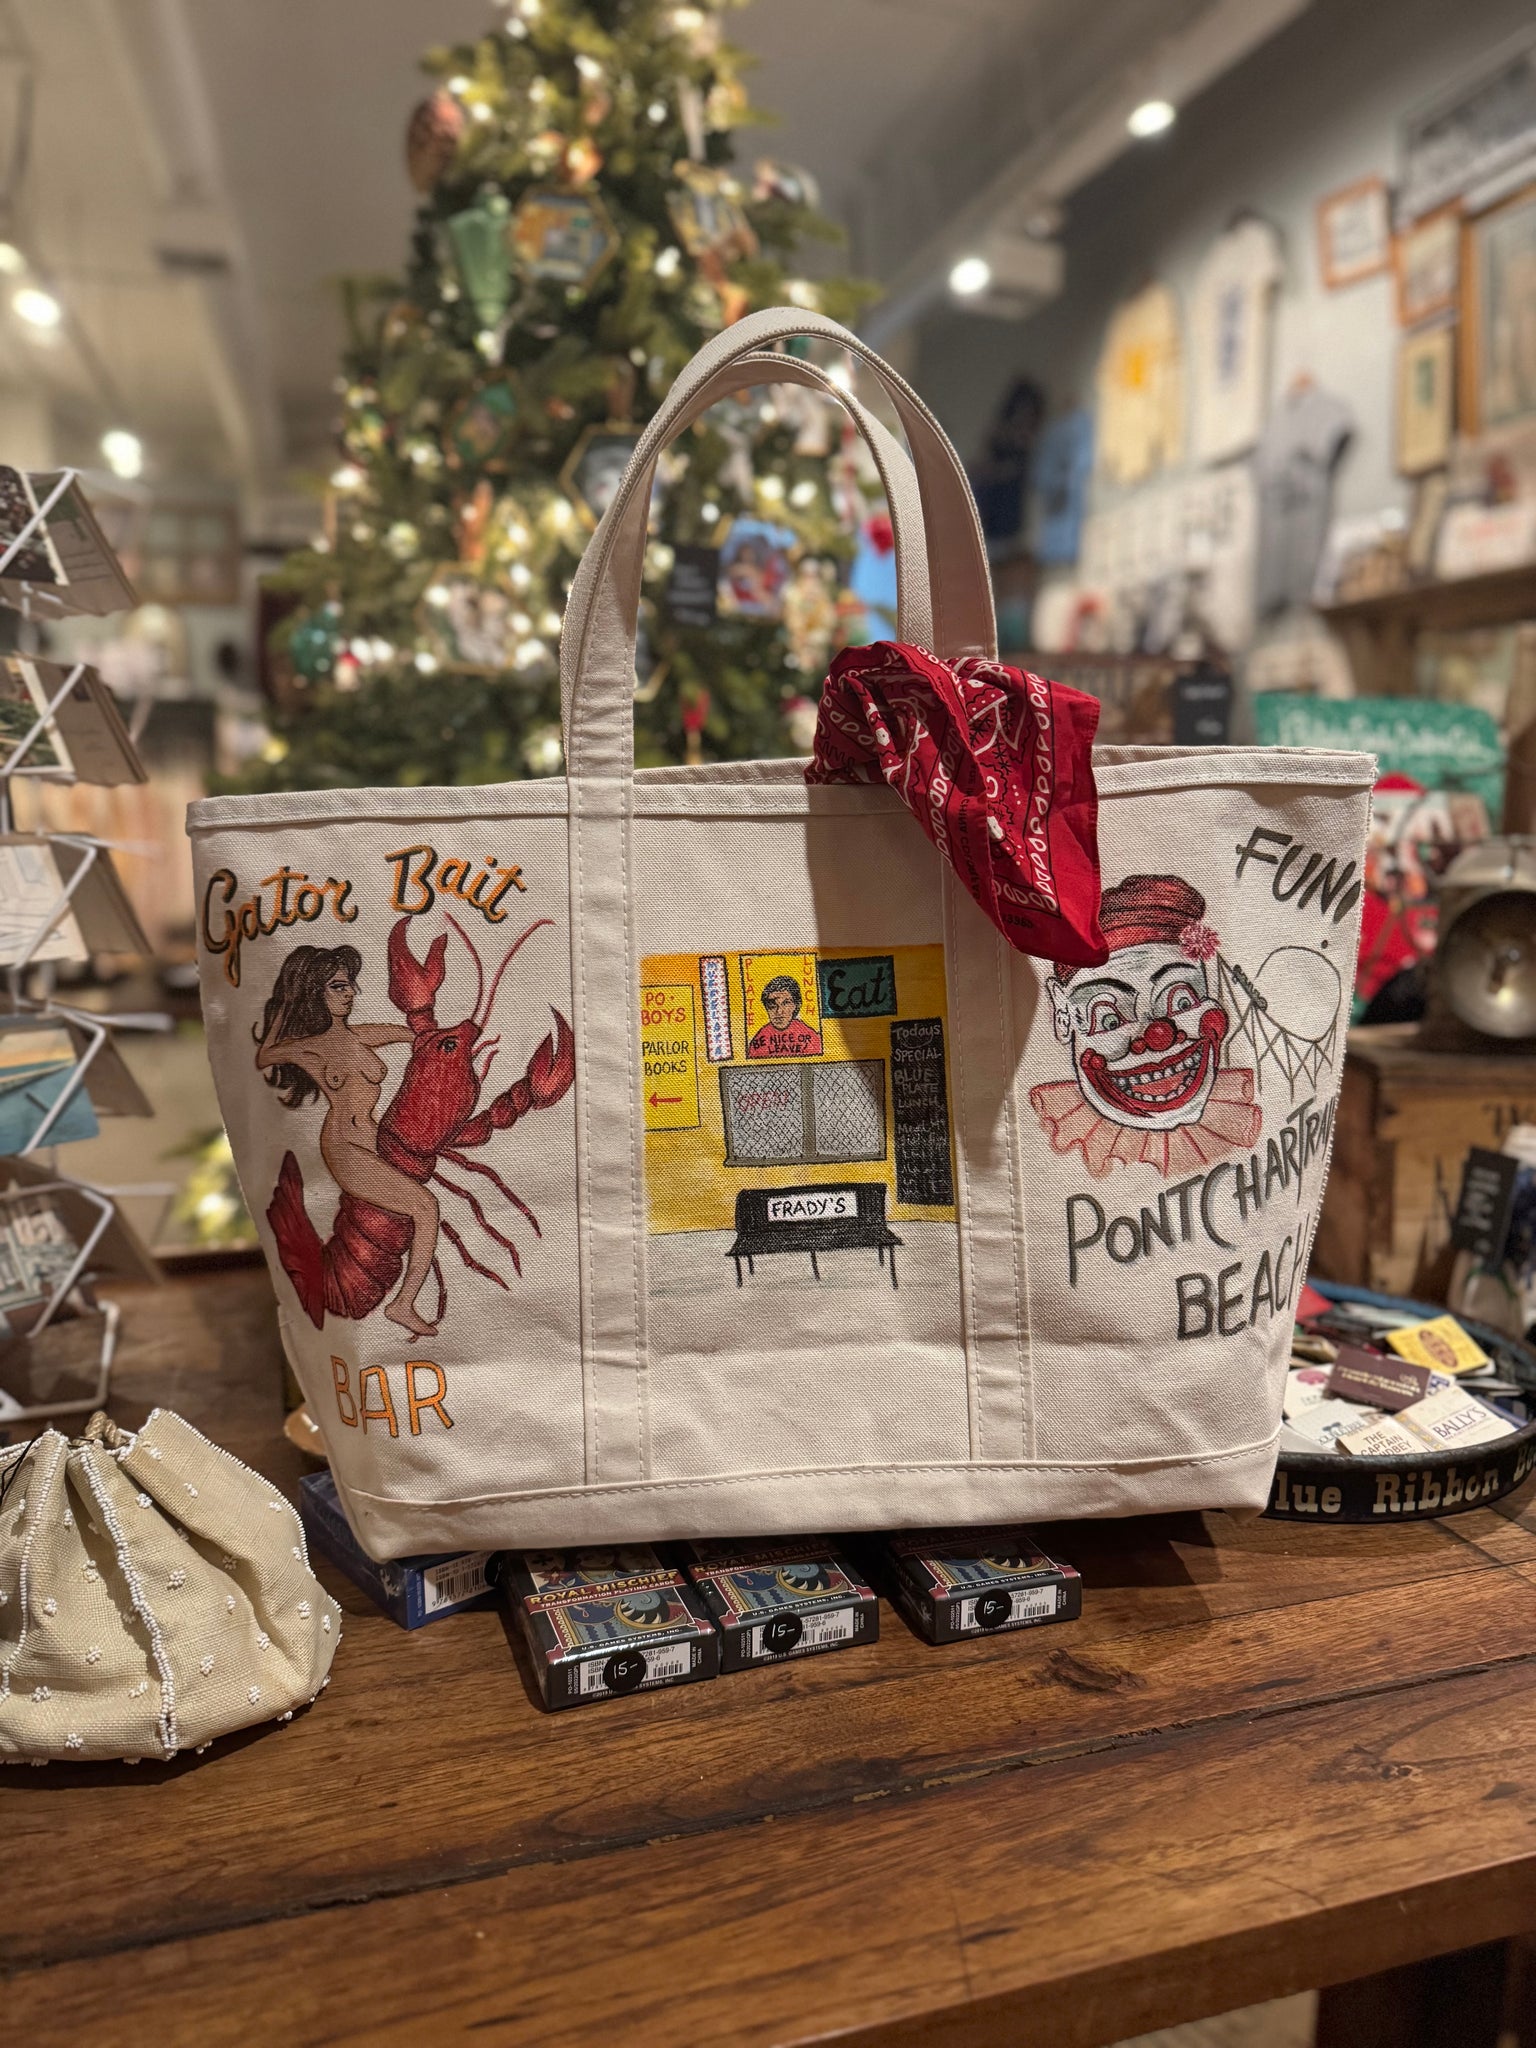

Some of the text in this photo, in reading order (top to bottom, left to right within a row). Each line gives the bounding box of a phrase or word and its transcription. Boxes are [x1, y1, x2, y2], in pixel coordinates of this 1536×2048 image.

[203, 844, 527, 987] Gator Bait
[745, 958, 755, 1027] PLATE
[803, 955, 816, 1016] LUNCH
[828, 966, 887, 1012] Eat
[640, 1008, 686, 1026] BOYS
[642, 1040, 689, 1056] PARLOR
[751, 1033, 811, 1050] BE NICE OR
[893, 1047, 943, 1063] SPECIAL
[644, 1060, 687, 1076] BOOKS
[894, 1068, 935, 1085] BLUE
[902, 1082, 938, 1096] PLATE
[771, 1196, 847, 1218] FRADY'S
[330, 1354, 454, 1439] BAR
[1432, 1407, 1488, 1440] BALLY'S
[1360, 1434, 1404, 1457] CAPTAIN
[1363, 1430, 1385, 1446] THE
[1275, 1467, 1499, 1514] lue Ribbon
[530, 1571, 678, 1605] ROYAL MISCHIEF
[541, 1580, 675, 1608] TRANSFORMATION PLAYING CARDS
[976, 1580, 1000, 1588] GAMES
[768, 1605, 793, 1613] GAMES
[598, 1638, 626, 1648] GAMES
